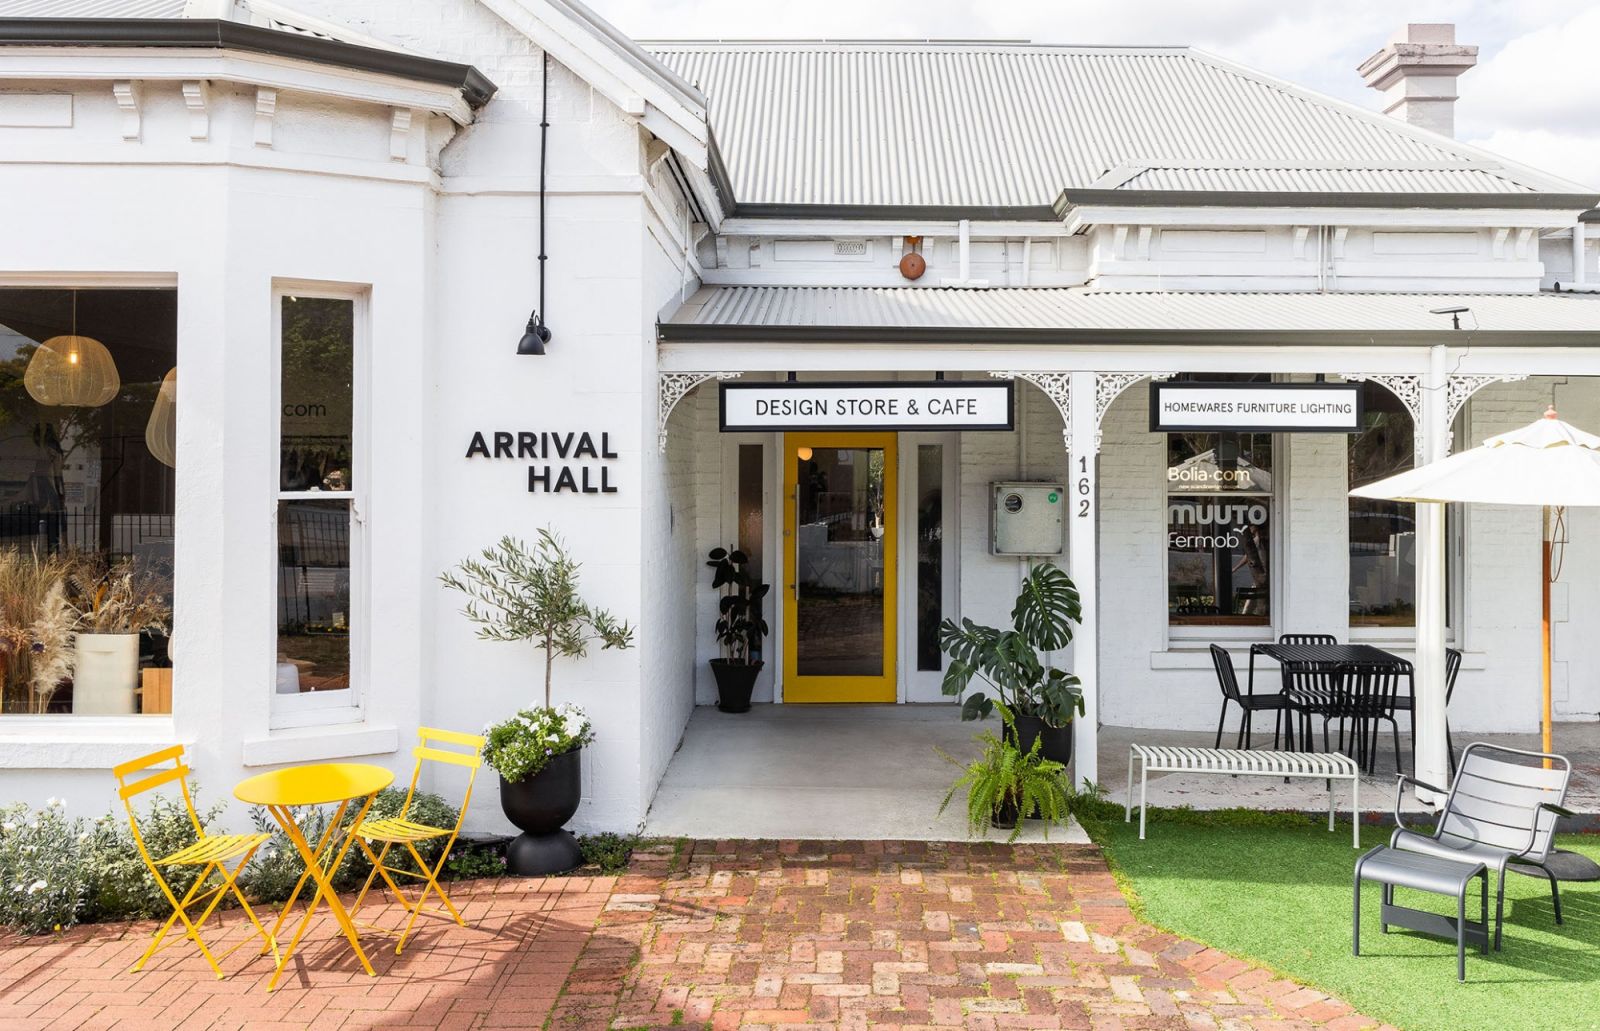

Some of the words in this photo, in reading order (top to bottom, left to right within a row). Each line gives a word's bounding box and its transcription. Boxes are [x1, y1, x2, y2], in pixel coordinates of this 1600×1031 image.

[756, 399, 828, 416] DESIGN
[836, 399, 899, 416] STORE
[907, 399, 920, 415] &
[927, 398, 978, 415] CAFE
[1164, 402, 1234, 413] HOMEWARES
[1237, 403, 1296, 414] FURNITURE
[1300, 403, 1352, 414] LIGHTING
[465, 432, 618, 459] ARRIVAL
[529, 466, 618, 493] HALL
[1078, 455, 1090, 518] 162
